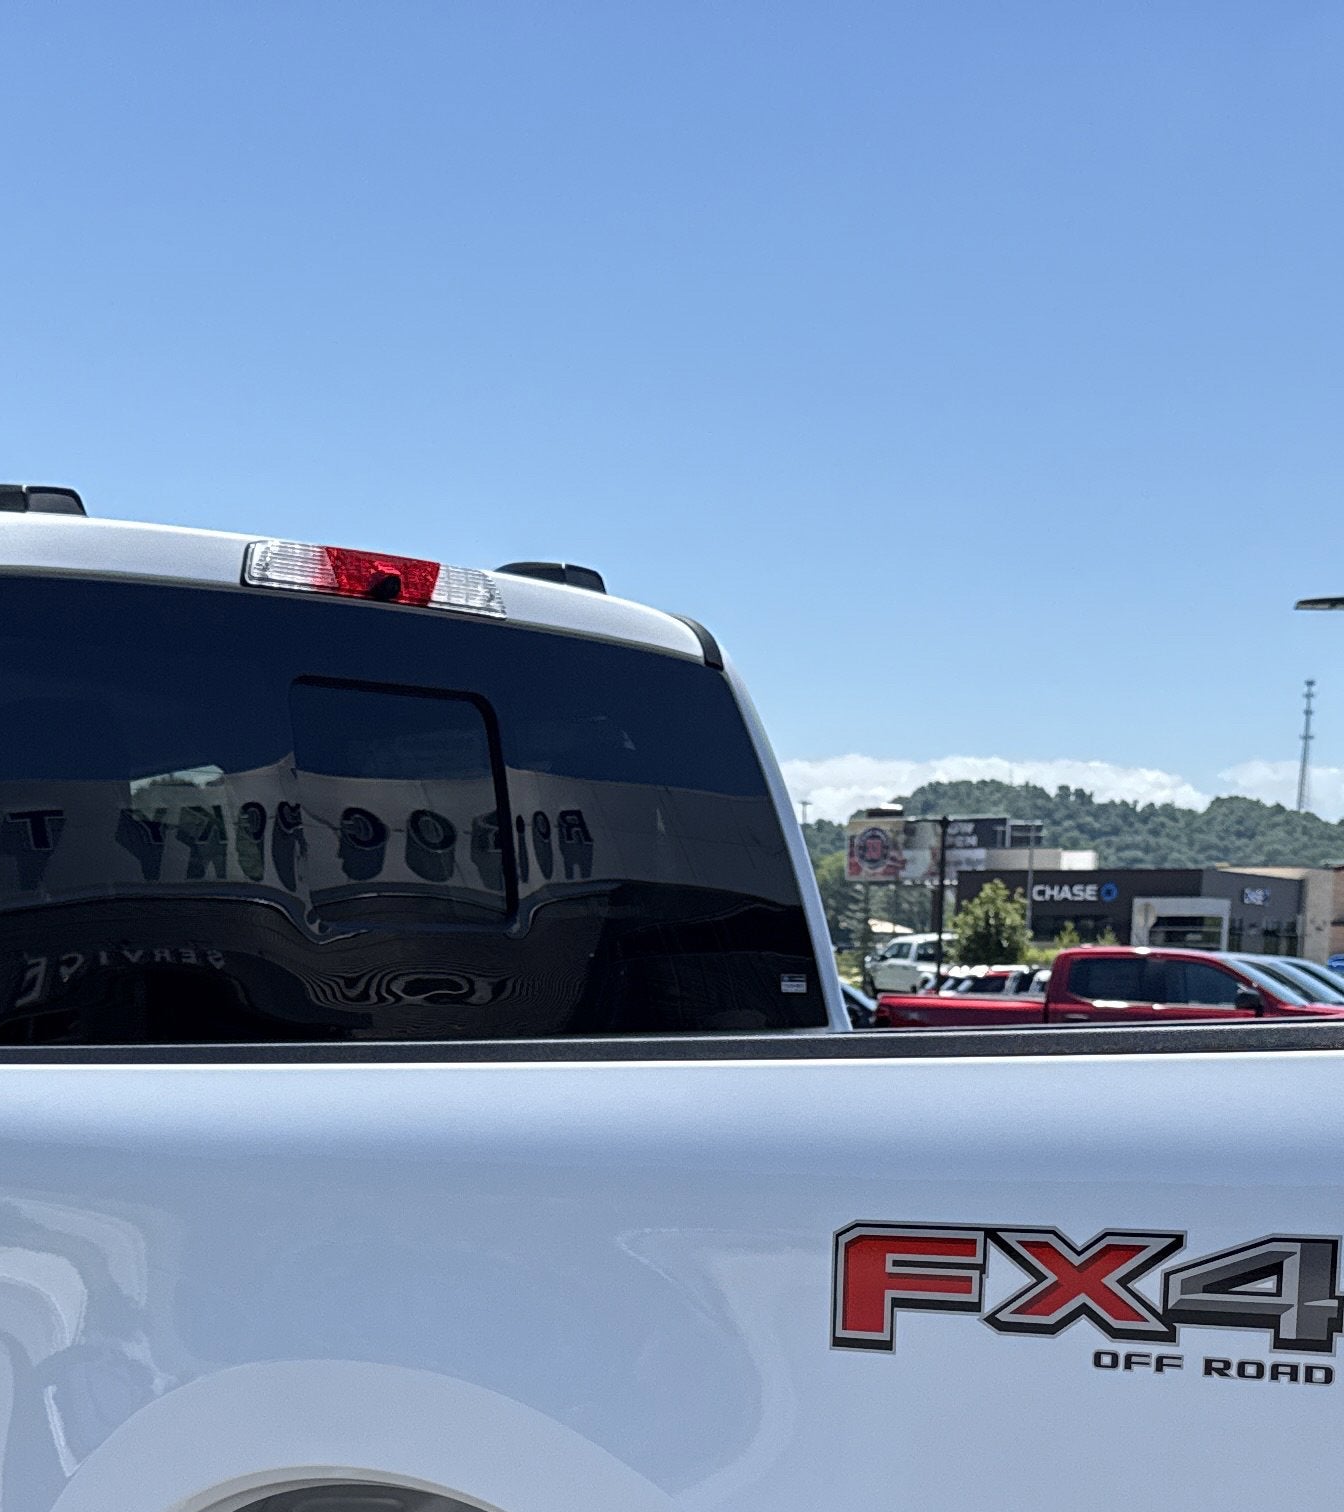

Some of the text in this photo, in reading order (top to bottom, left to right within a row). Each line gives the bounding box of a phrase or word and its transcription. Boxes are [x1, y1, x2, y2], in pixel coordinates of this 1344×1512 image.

[1032, 883, 1099, 902] CHASE
[1091, 1349, 1336, 1387] OFF ROAD
